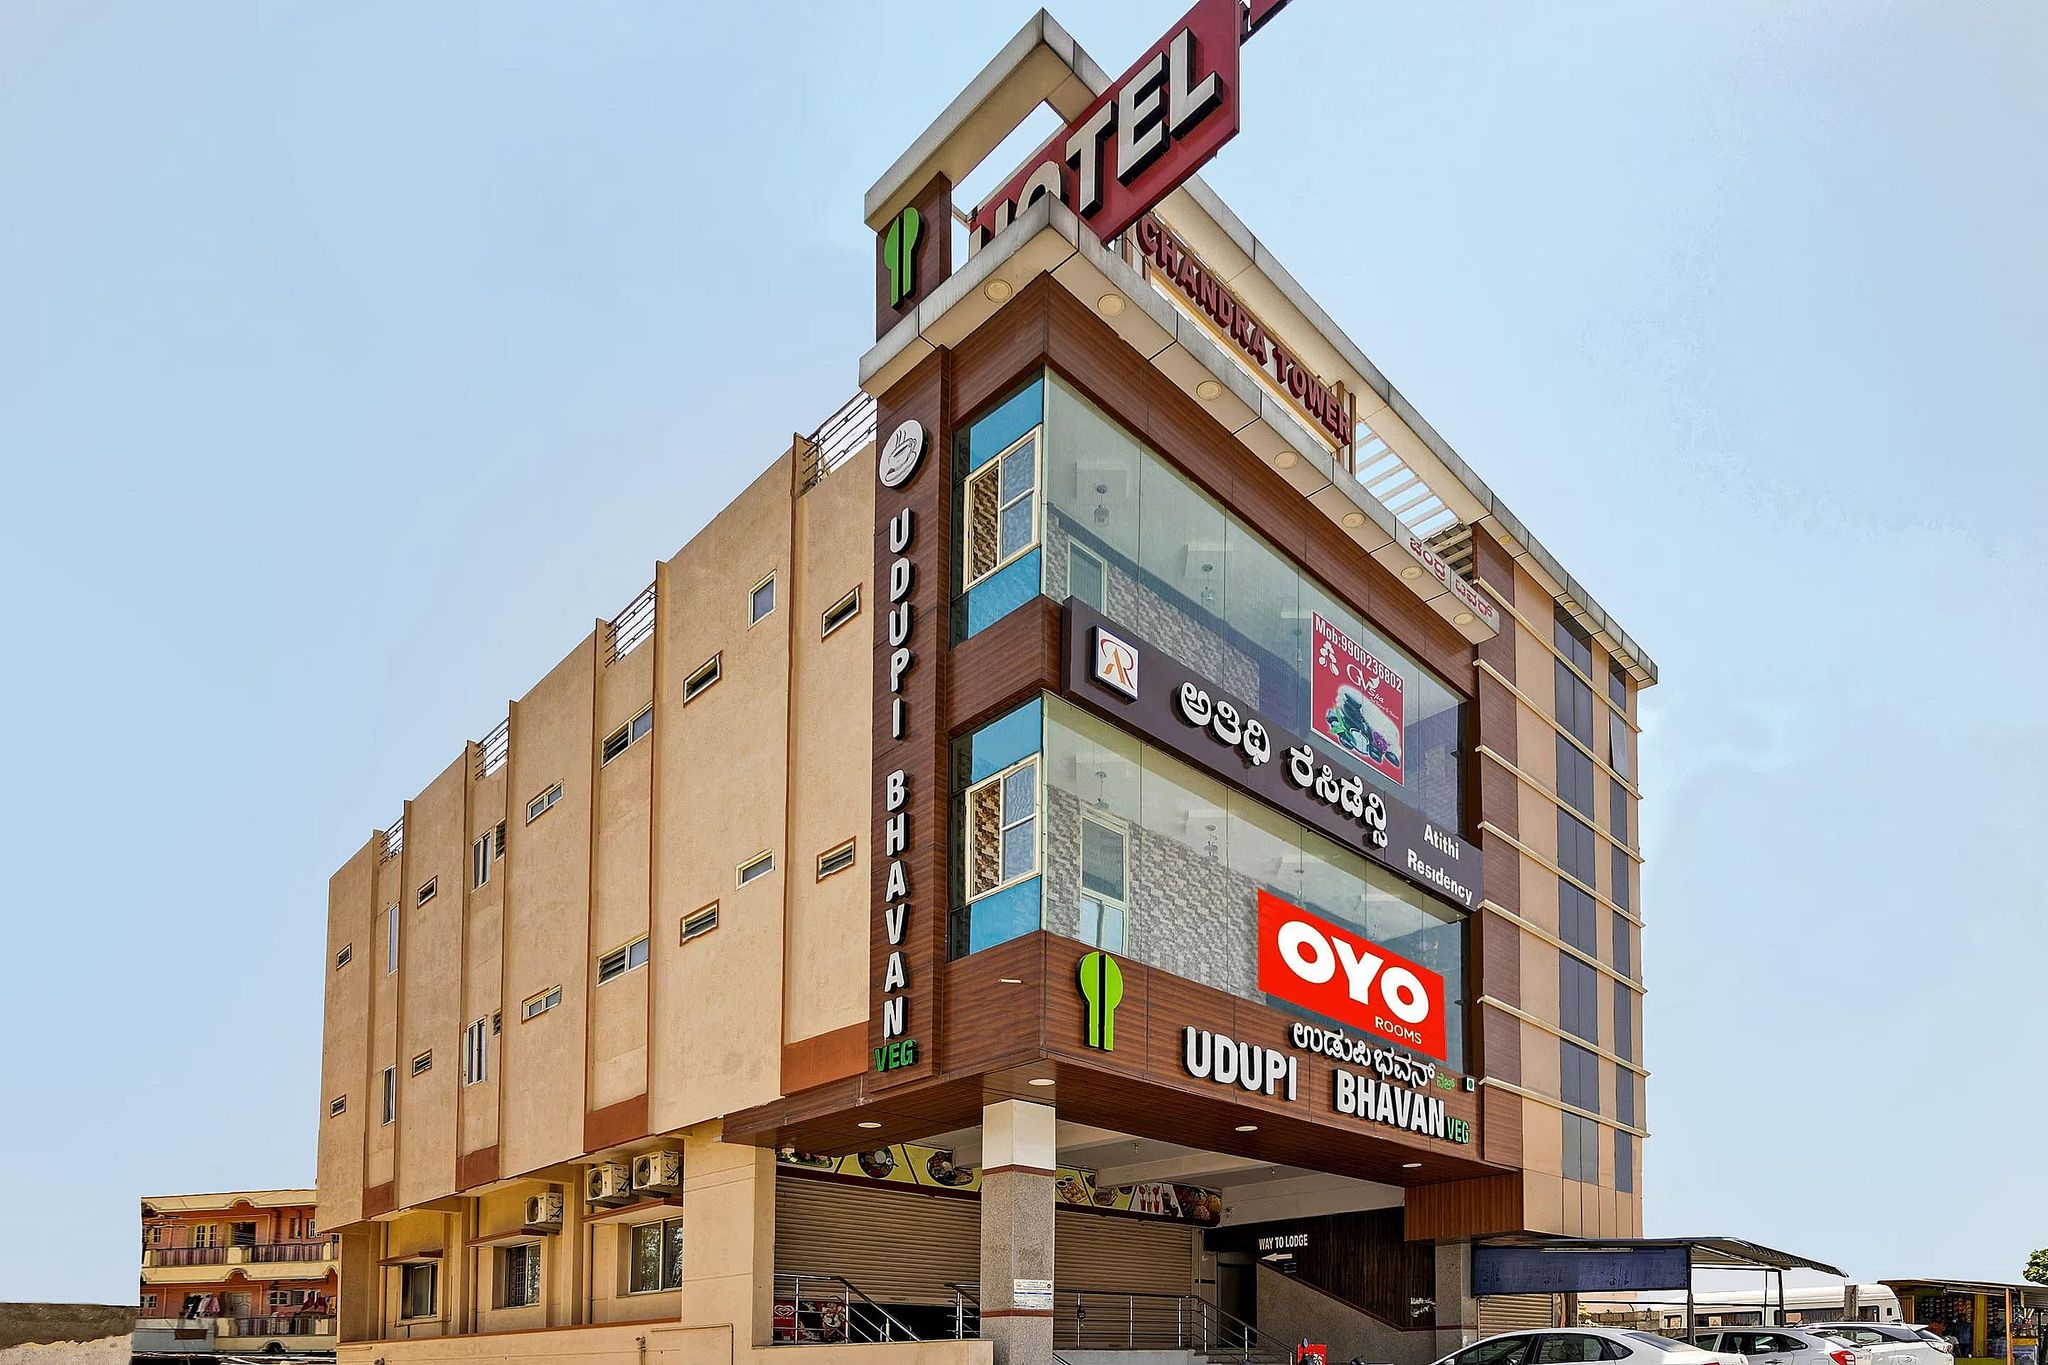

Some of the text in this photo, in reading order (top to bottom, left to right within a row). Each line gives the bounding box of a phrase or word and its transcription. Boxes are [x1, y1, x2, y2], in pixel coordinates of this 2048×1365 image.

[1136, 213, 1351, 447] CHANDRA TOWER
[889, 507, 911, 738] UDUPI
[1315, 615, 1403, 693] Mob:9900236802
[1180, 681, 1272, 766] ಅತಿಥಿ
[1407, 848, 1473, 906] Residency
[1423, 823, 1459, 860] Atithi
[884, 769, 906, 1038] BHAVAN
[1277, 920, 1430, 1024] OYO
[874, 1039, 915, 1073] VEG
[1374, 1015, 1422, 1045] ROOMS
[1186, 1025, 1470, 1144] UDUPI BHAVAN VEG
[1258, 1233, 1309, 1251] WAY TO LODGE
